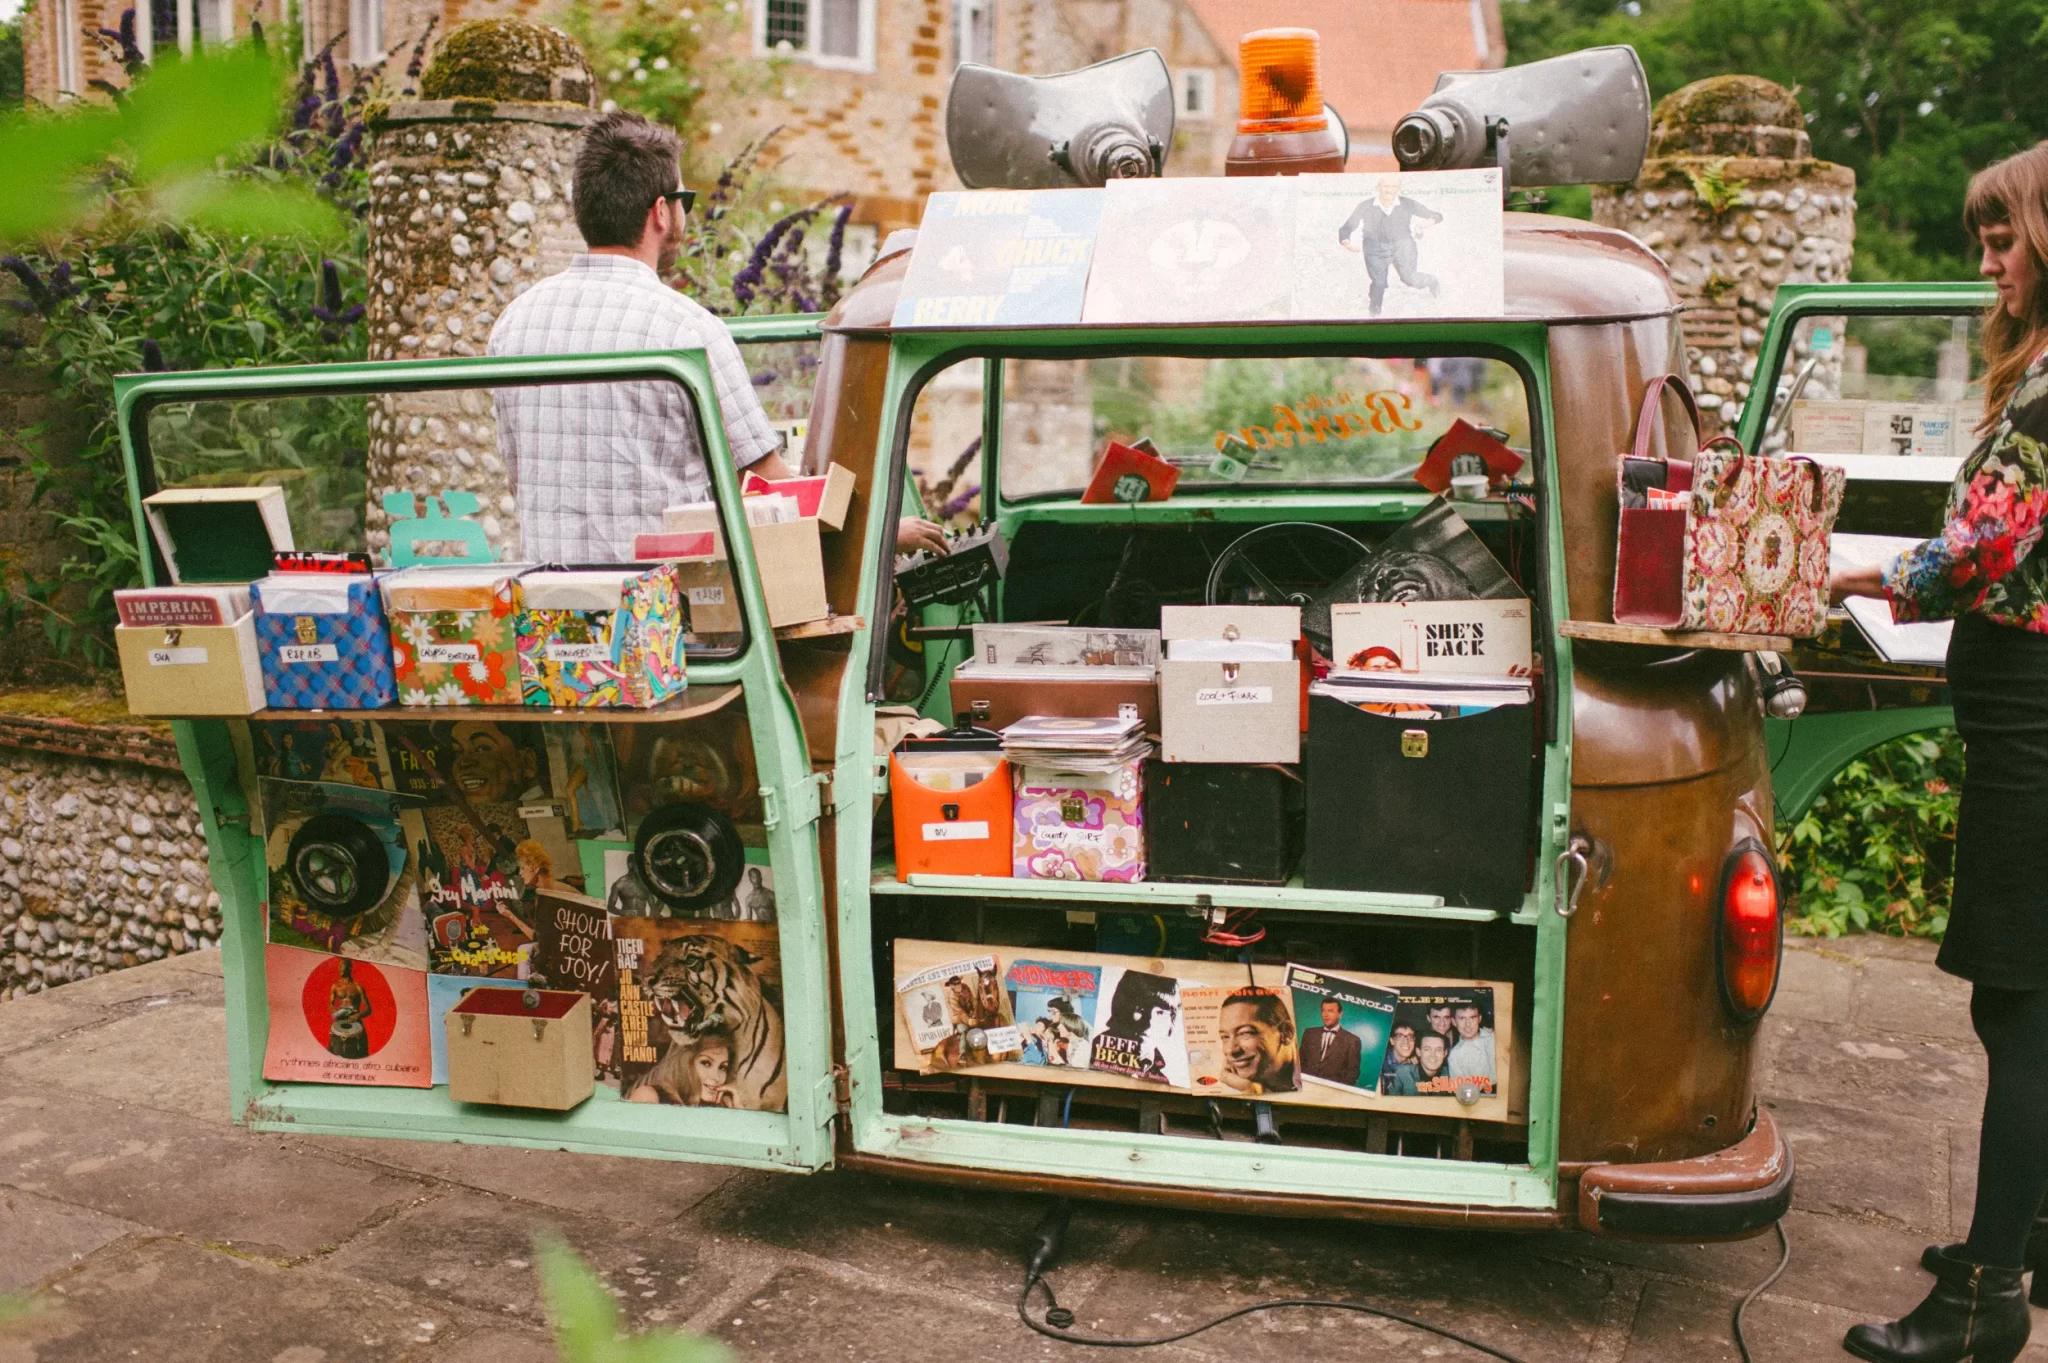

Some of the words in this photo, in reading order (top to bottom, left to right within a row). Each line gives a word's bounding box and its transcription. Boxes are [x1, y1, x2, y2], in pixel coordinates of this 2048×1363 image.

[999, 239, 1090, 266] CHUCK
[913, 296, 1006, 325] BERRY
[126, 600, 213, 615] IMPERIAL
[1426, 623, 1484, 640] SHE'S
[154, 652, 171, 662] SKA
[1426, 640, 1485, 657] BACK
[460, 874, 520, 901] Martini
[553, 907, 608, 939] SHOUT
[559, 934, 592, 958] FOR
[616, 938, 644, 955] TIGER
[559, 956, 610, 984] JOY!
[617, 954, 639, 970] RAG
[620, 969, 633, 985] JO
[1007, 965, 1096, 991] MONKEES
[620, 984, 640, 1001] ANN
[1182, 989, 1219, 997] henri
[1290, 980, 1331, 996] EDDY
[1332, 992, 1394, 1013] ARNOLD
[620, 1000, 655, 1017] CASTLE
[623, 1030, 648, 1047] WILD
[1099, 1034, 1139, 1054] JEFF
[623, 1046, 657, 1063] PIANO!
[1095, 1047, 1141, 1069] BECK
[362, 1061, 381, 1071] afro
